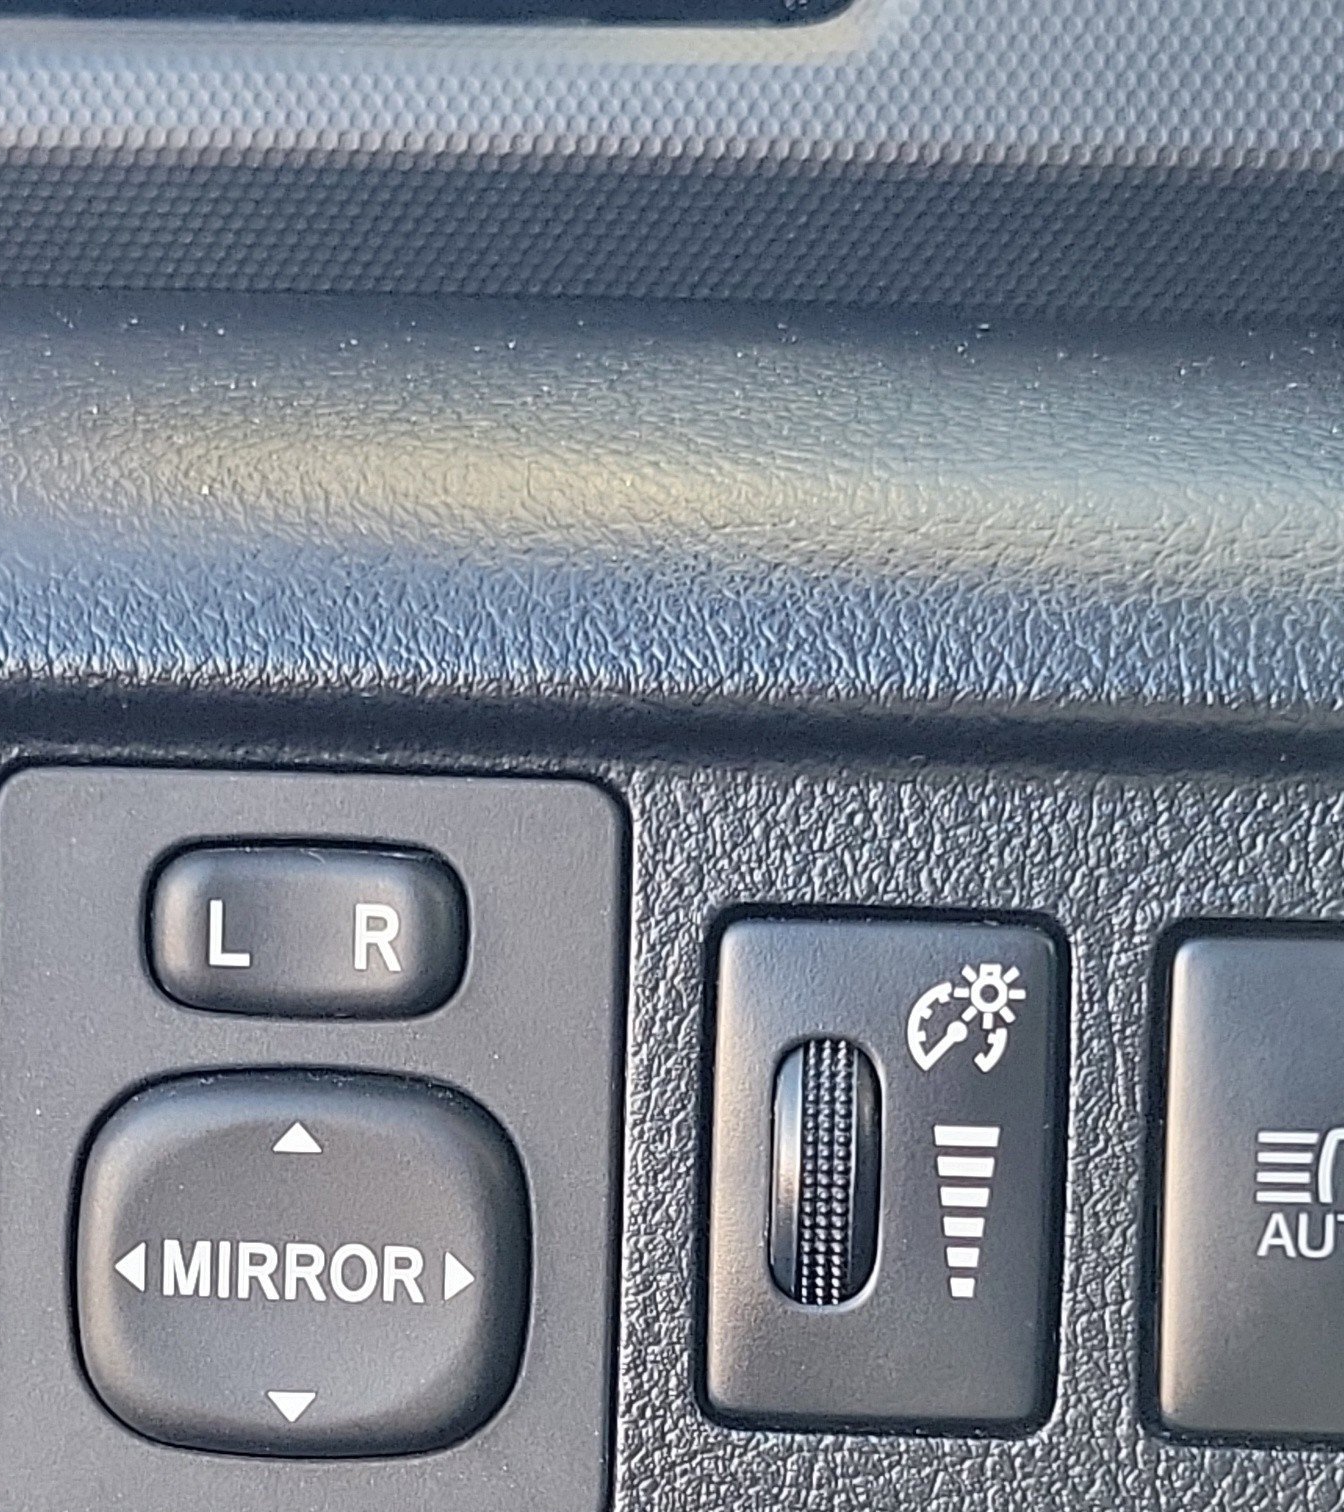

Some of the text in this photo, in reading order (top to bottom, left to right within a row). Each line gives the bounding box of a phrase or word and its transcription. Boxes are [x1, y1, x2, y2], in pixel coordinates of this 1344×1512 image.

[208, 899, 402, 972] L R
[161, 1239, 425, 1304] MIRROR
